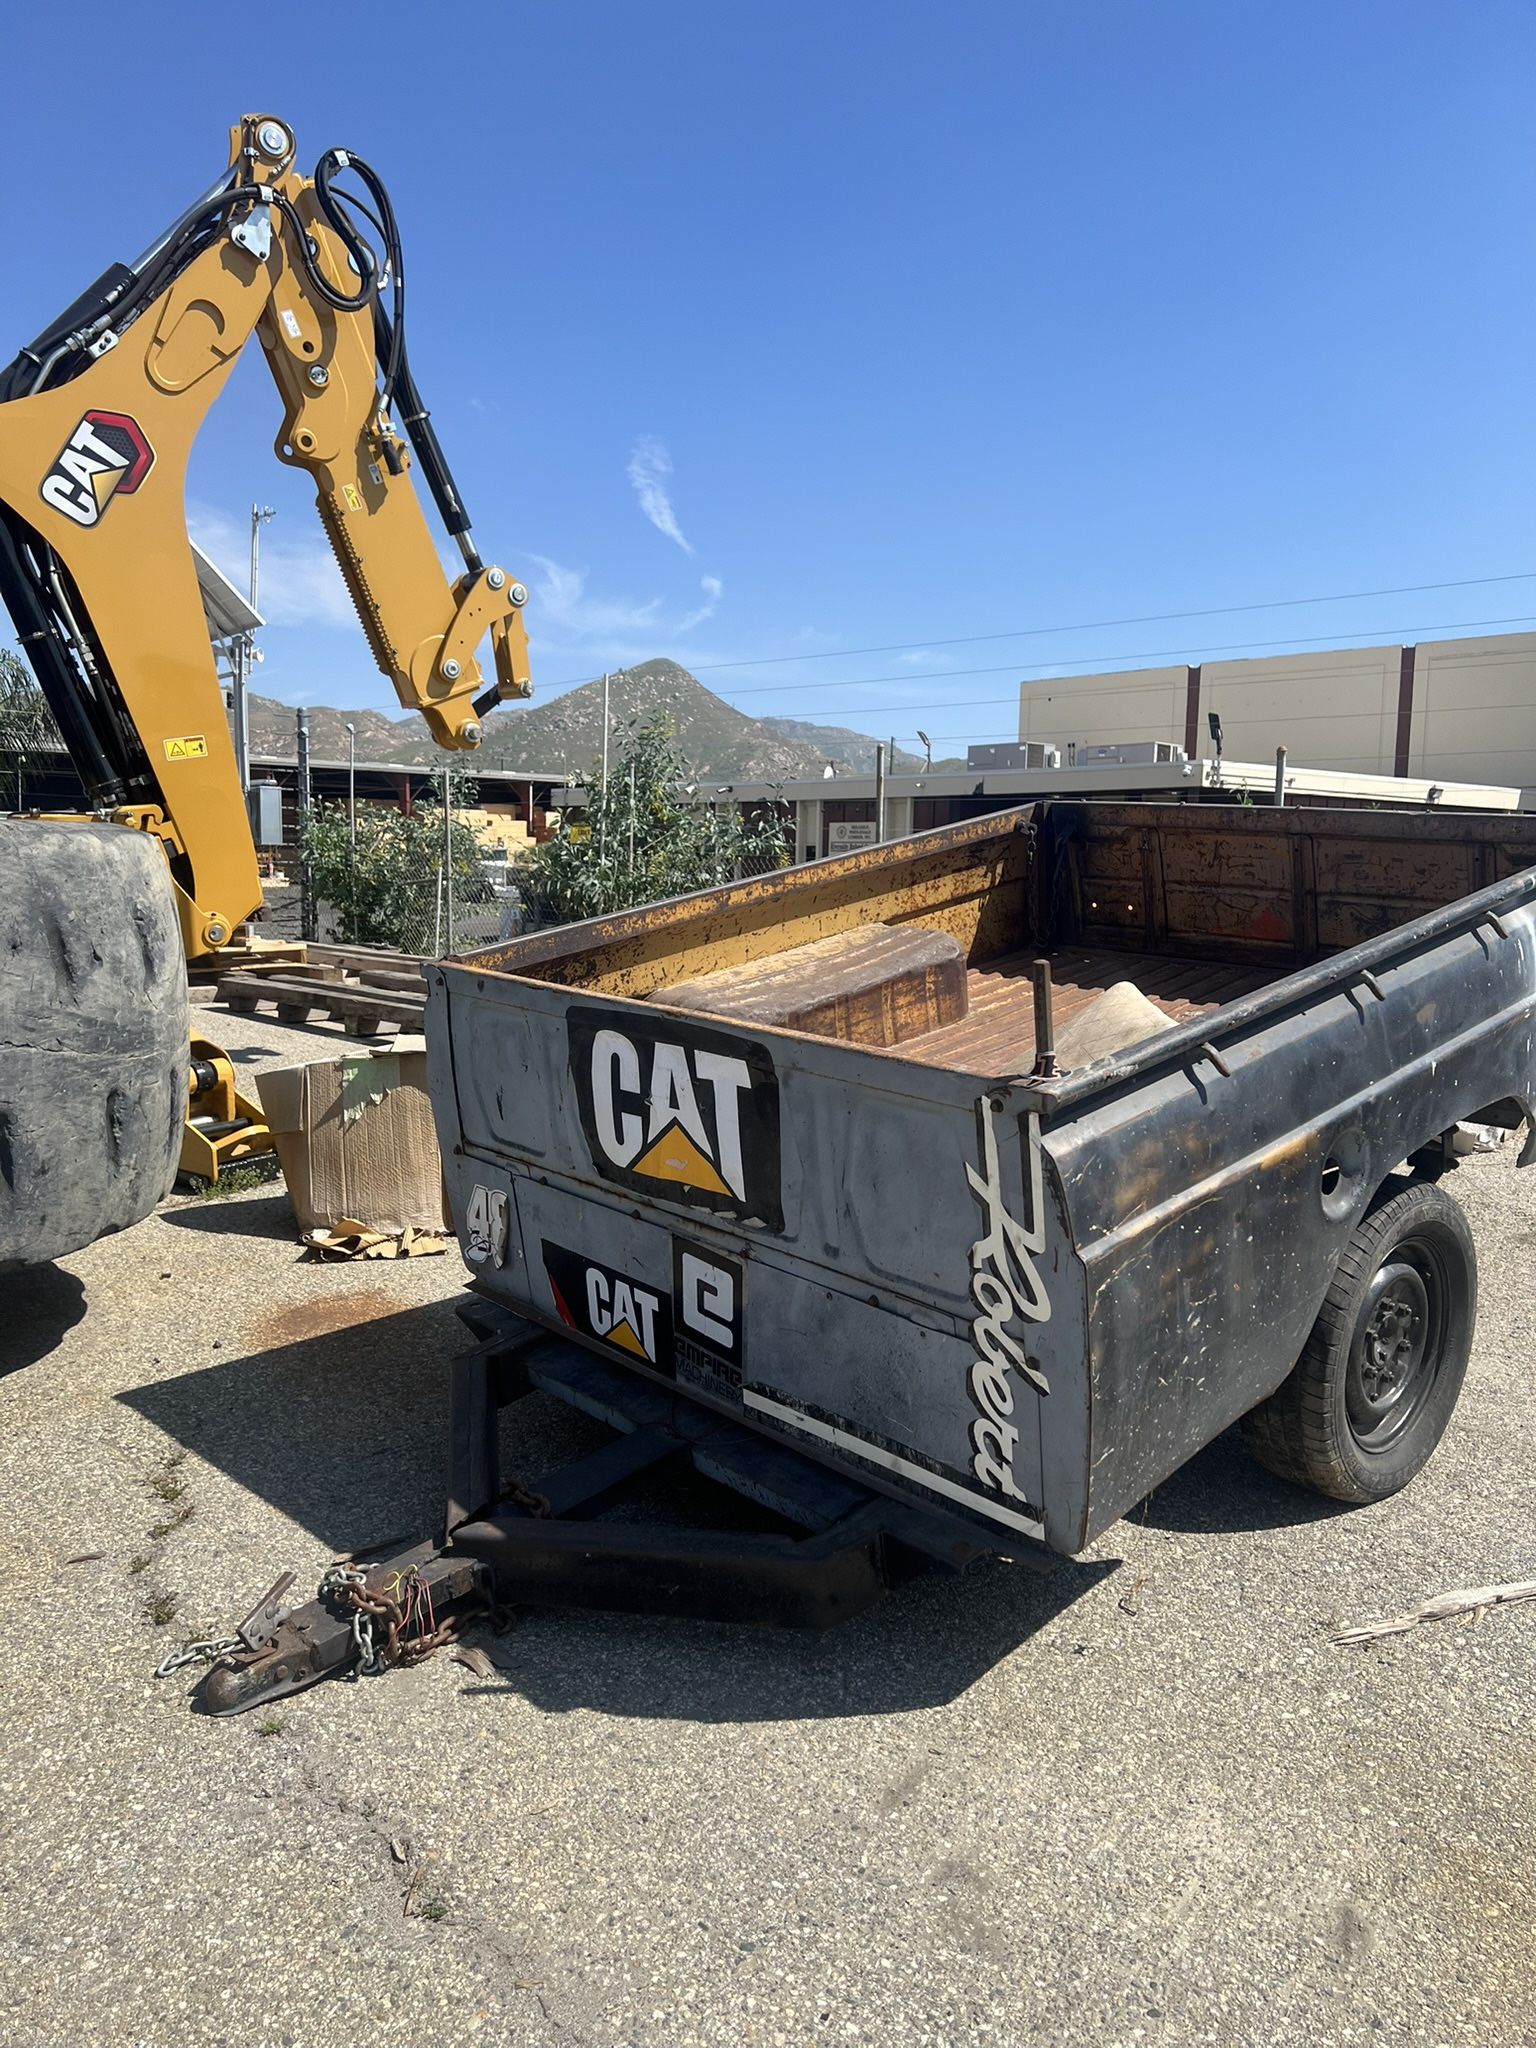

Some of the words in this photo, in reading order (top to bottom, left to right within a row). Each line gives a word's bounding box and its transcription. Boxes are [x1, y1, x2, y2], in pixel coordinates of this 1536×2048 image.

[41, 419, 130, 526] CAT
[591, 1029, 752, 1203] CAT
[585, 1267, 660, 1363] CAT
[676, 1356, 742, 1403] MACHINERY
